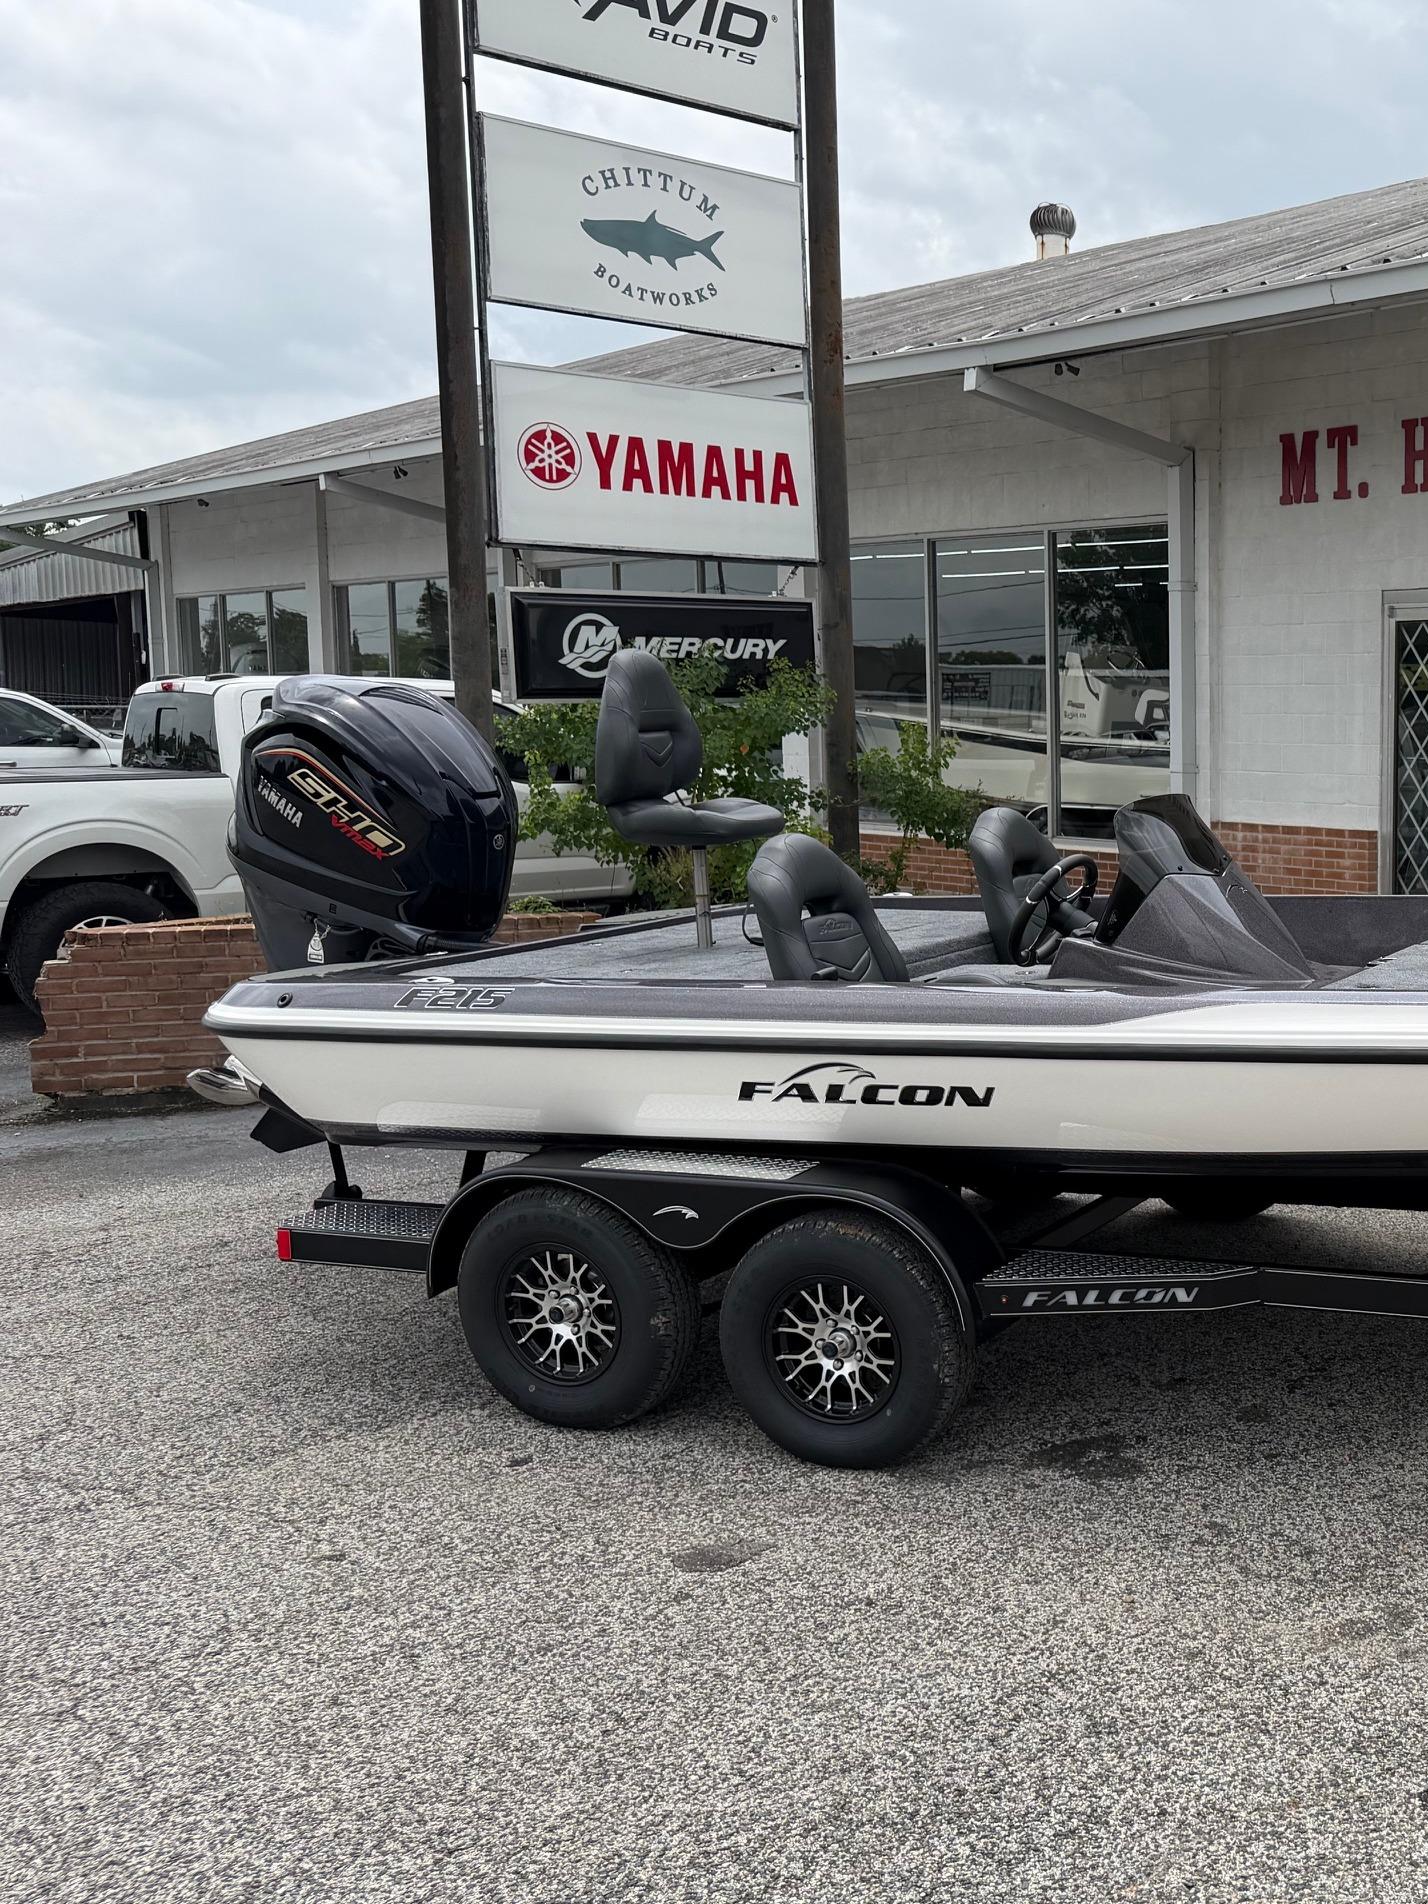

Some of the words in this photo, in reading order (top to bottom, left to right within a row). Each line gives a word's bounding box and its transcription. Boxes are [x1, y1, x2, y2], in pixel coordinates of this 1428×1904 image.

[648, 27, 757, 65] BOATS
[581, 166, 720, 221] CHITTUM
[593, 263, 718, 307] BOATWORKS
[586, 431, 799, 506] YAMAHA
[1278, 424, 1370, 506] MT.
[631, 636, 787, 660] MERCURY
[256, 775, 303, 829] YAMAHA
[287, 768, 406, 857] SHO
[393, 987, 516, 1010] F215
[737, 1081, 996, 1108] FALCON
[1021, 1286, 1200, 1307] FALCON
